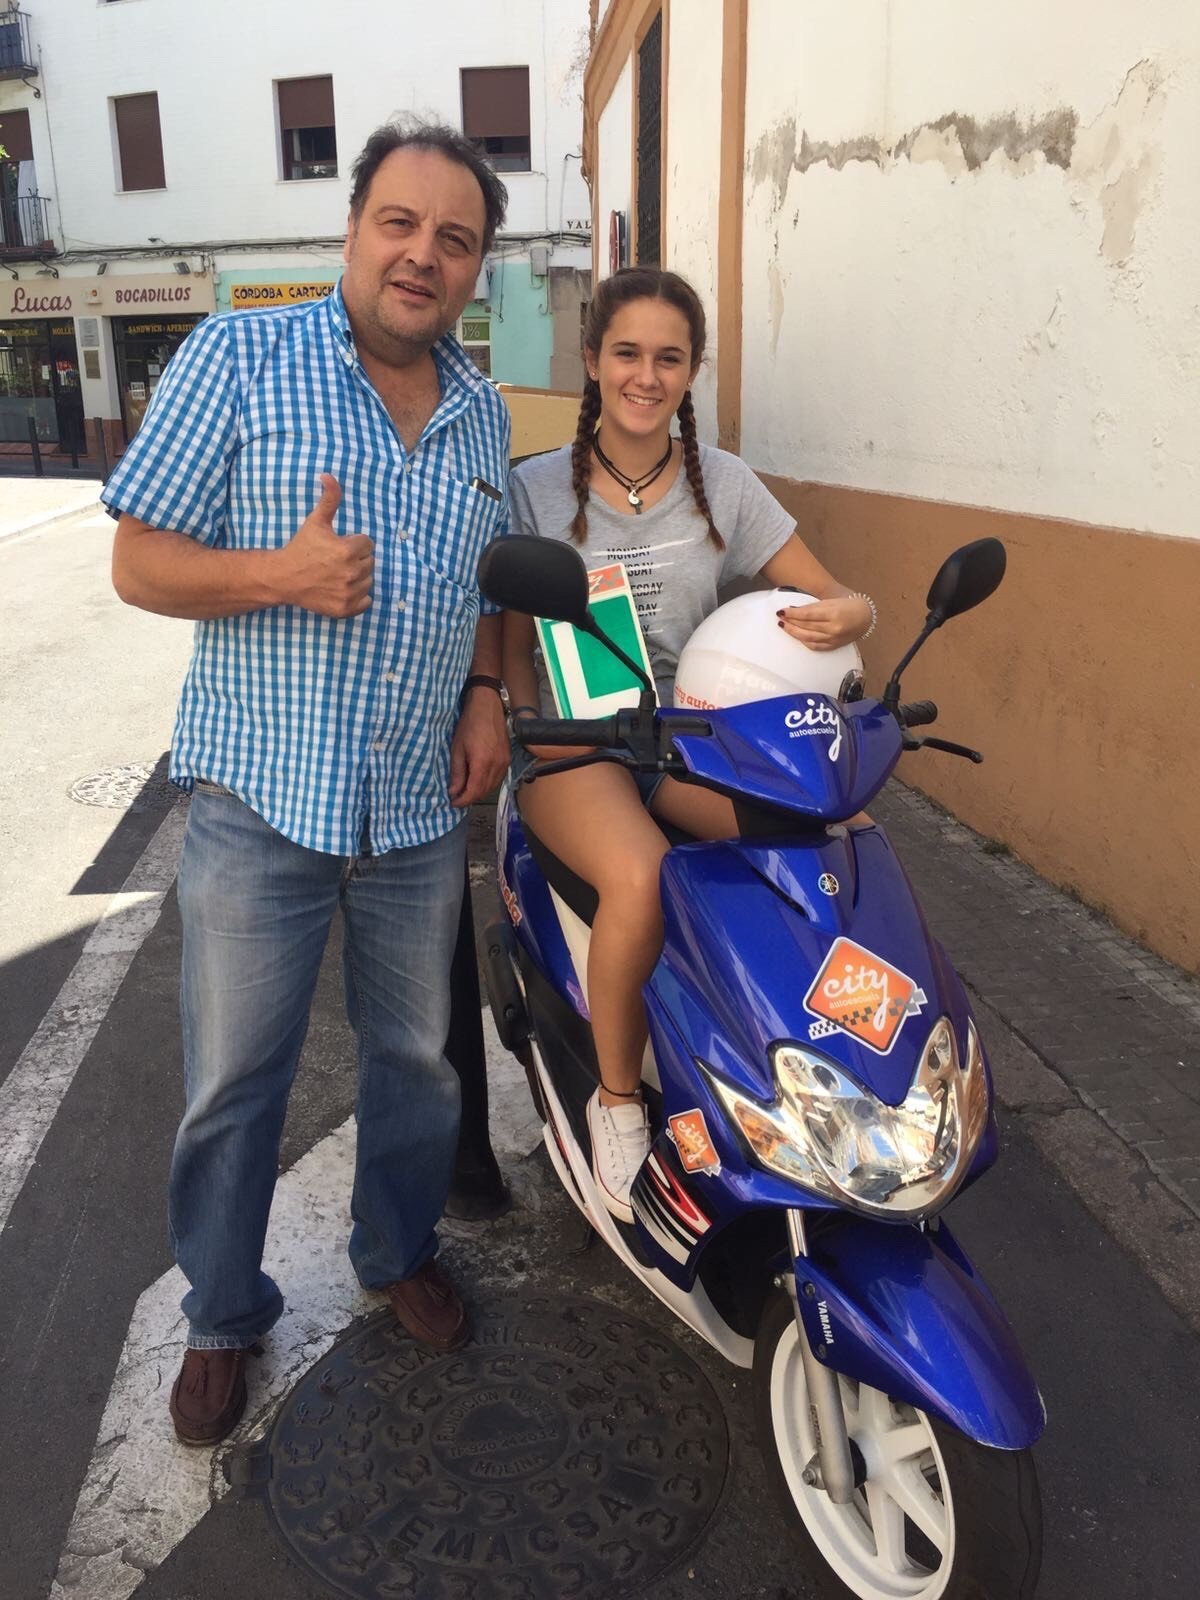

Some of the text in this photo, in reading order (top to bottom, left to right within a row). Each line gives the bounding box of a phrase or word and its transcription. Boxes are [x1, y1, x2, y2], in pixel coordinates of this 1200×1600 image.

[567, 221, 592, 230] VAL
[10, 286, 73, 314] Lucas
[115, 287, 192, 304] BOCADILLOS
[288, 285, 336, 299] CARTUCH
[785, 698, 843, 762] city
[788, 726, 836, 739] autoescuela
[823, 963, 890, 1032] city
[816, 1300, 834, 1345] YAMAHA
